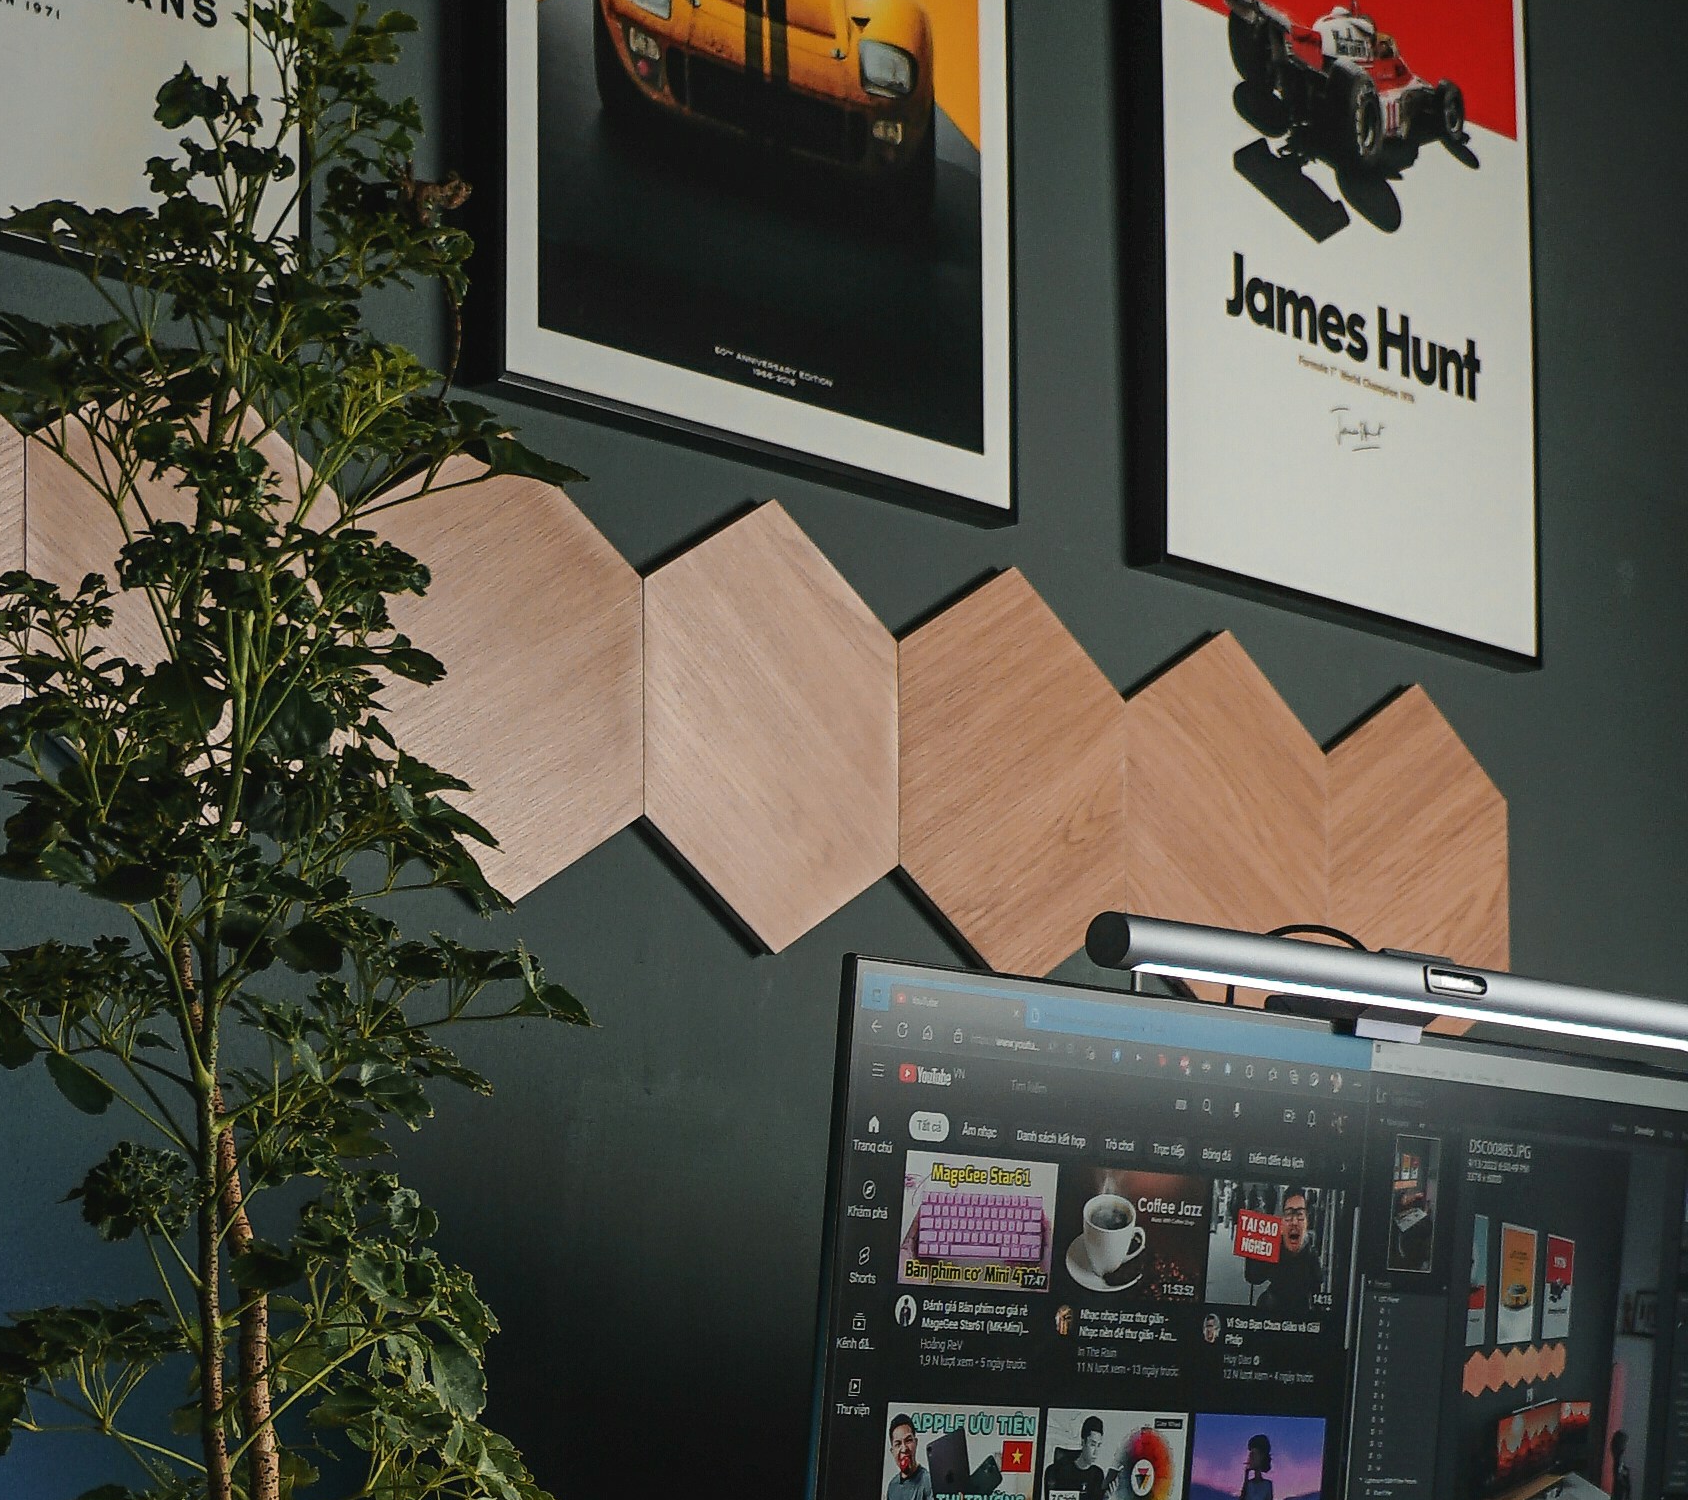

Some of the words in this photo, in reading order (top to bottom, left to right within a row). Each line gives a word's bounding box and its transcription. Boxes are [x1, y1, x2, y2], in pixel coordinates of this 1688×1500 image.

[25, 0, 62, 20] 1971
[1227, 251, 1368, 363] James
[1378, 305, 1481, 402] Hunt
[917, 1066, 952, 1087] YouTube
[853, 1138, 878, 1154] Trang
[931, 1162, 987, 1188] MageGee
[991, 1166, 1031, 1187] Star61
[1137, 1197, 1175, 1215] Coffee
[1177, 1200, 1203, 1218] Jazz
[1259, 1220, 1278, 1237] SAO
[848, 1271, 877, 1285] Shorts
[905, 1259, 928, 1279] Bàn
[984, 1265, 1009, 1284] Mini
[1023, 1274, 1046, 1287] 17:47
[911, 1412, 965, 1434] APPLE
